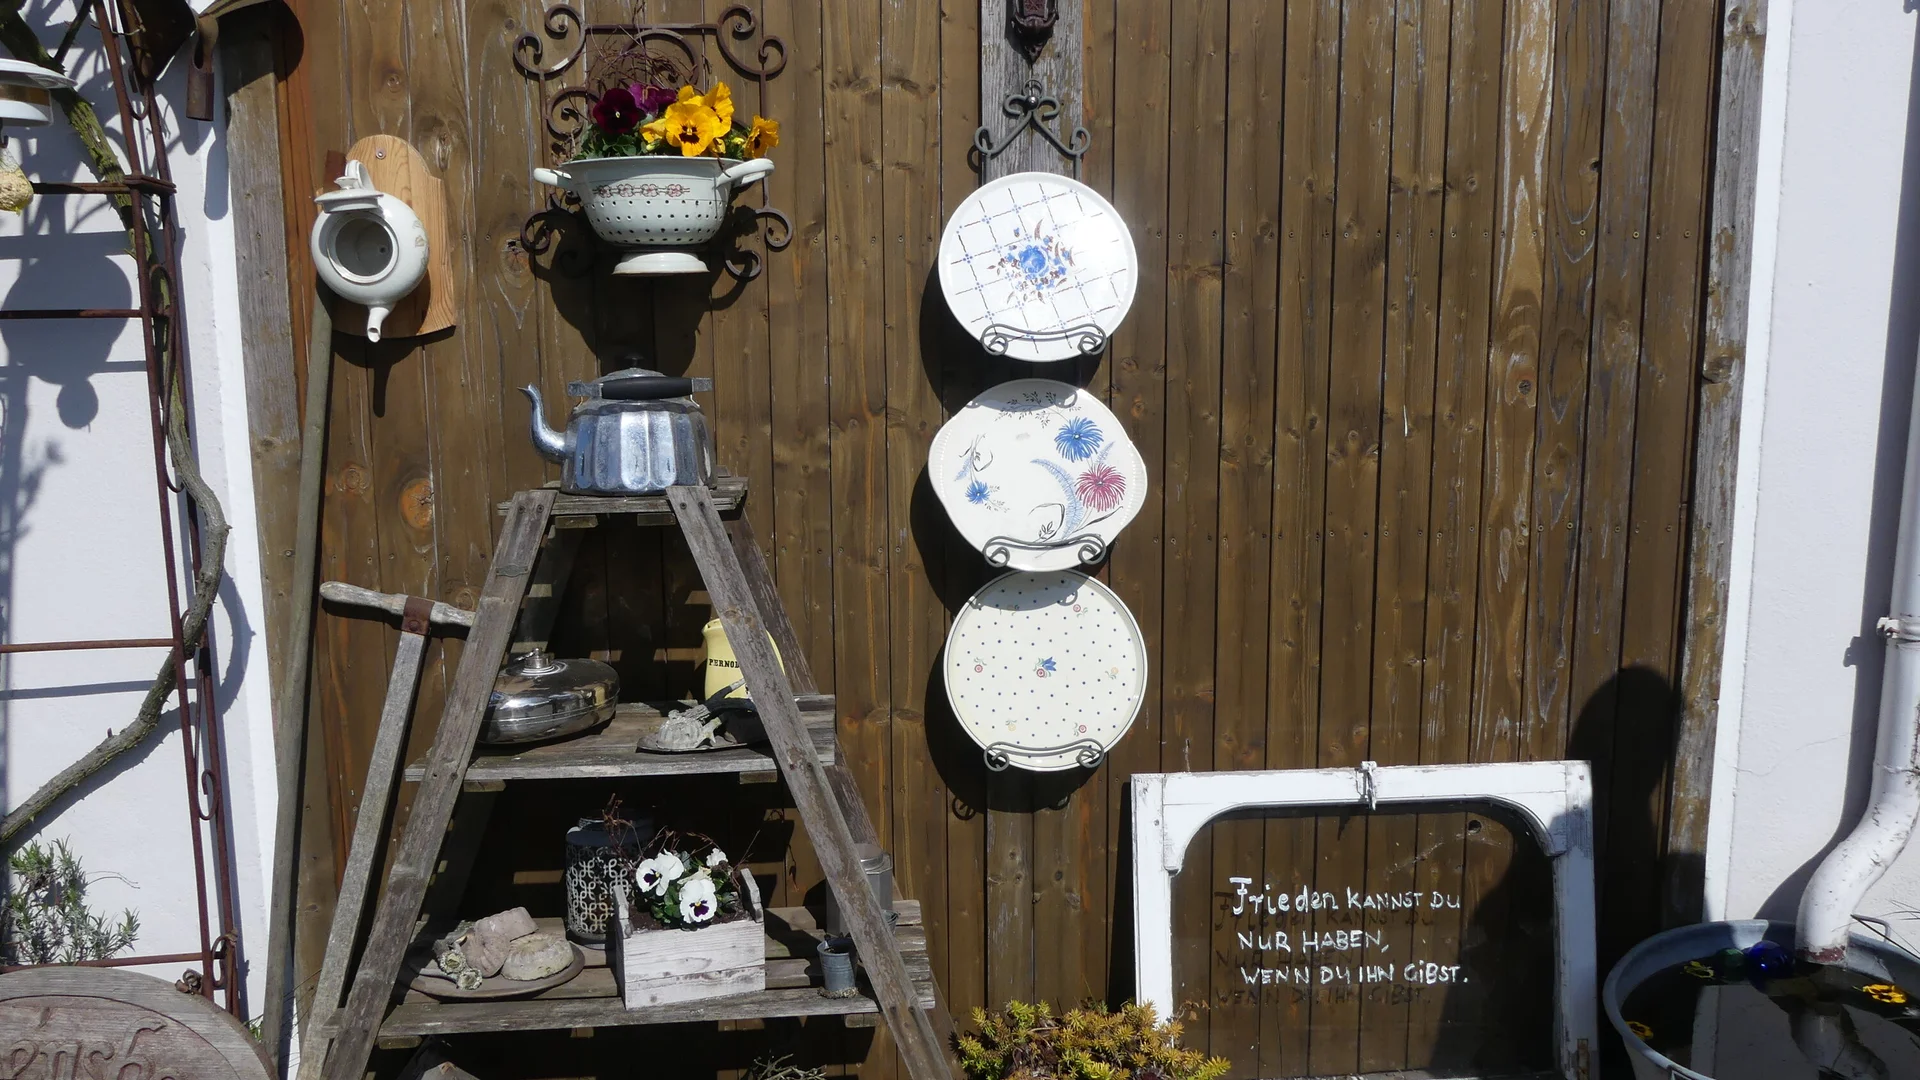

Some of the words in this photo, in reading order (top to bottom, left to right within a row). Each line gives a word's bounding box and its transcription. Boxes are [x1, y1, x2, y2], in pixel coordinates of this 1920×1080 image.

[1229, 876, 1339, 915] Frieden
[1347, 886, 1424, 911] KANNST
[1237, 930, 1292, 953] NUR
[1302, 929, 1390, 954] HABEN,
[1240, 964, 1310, 985] WENN
[1358, 963, 1395, 984] IHN
